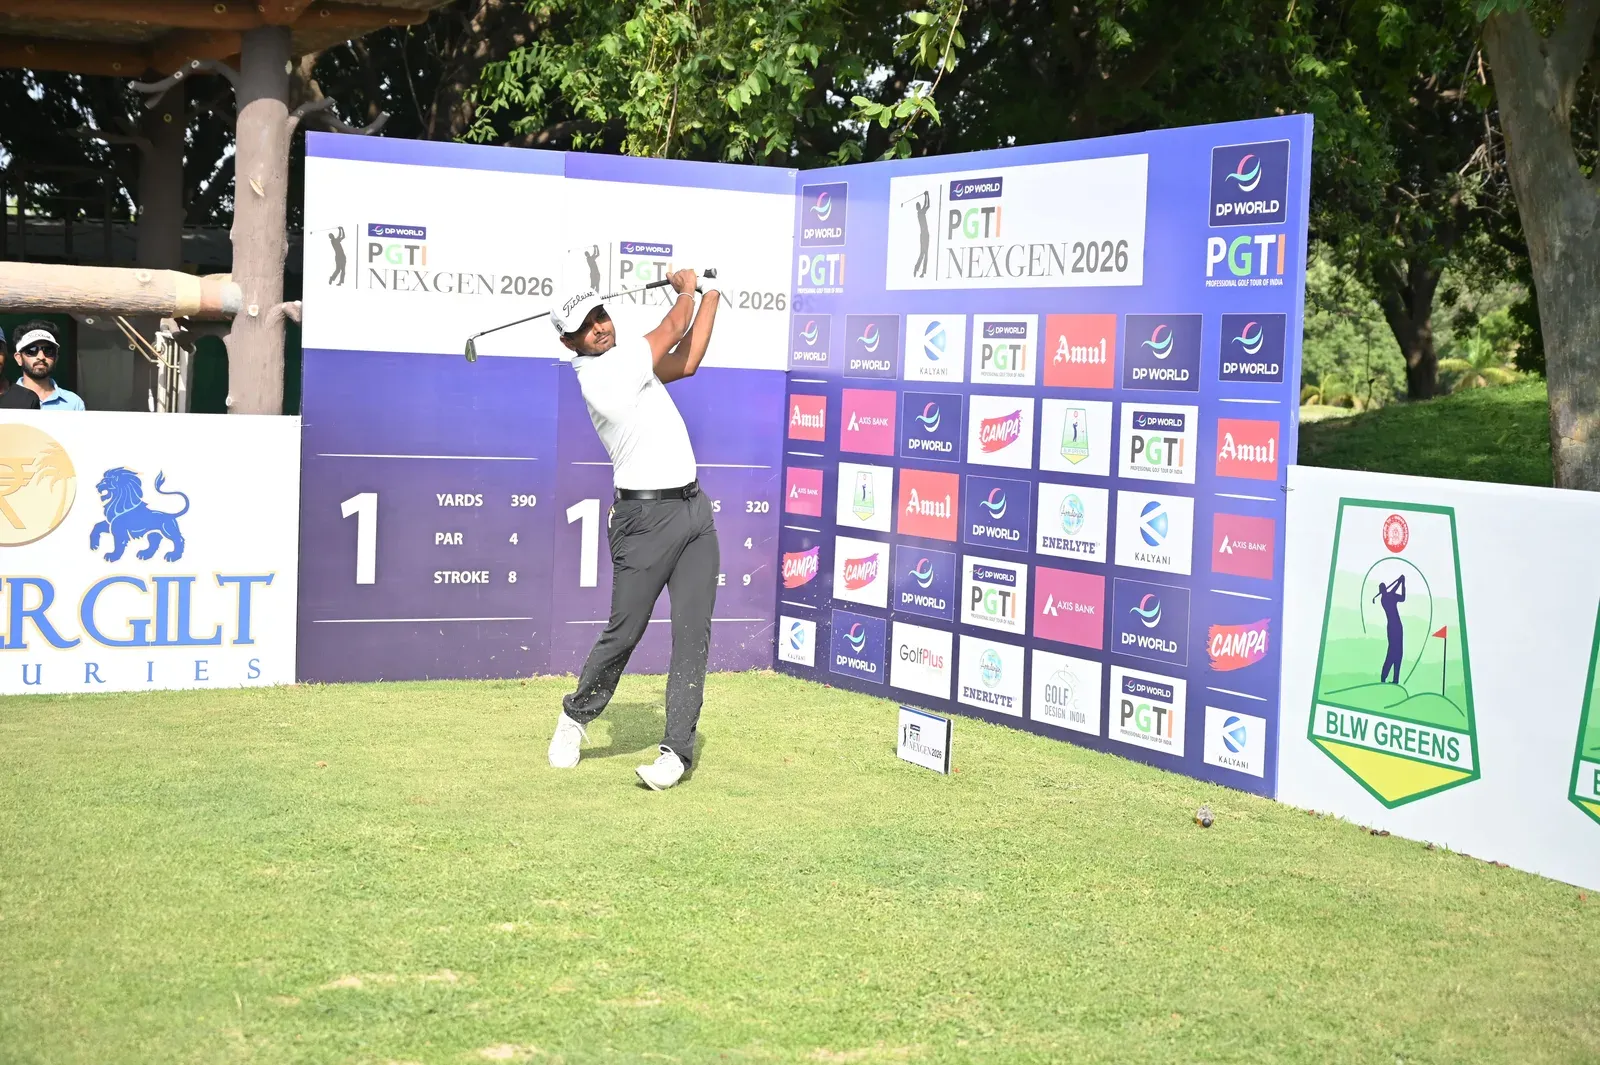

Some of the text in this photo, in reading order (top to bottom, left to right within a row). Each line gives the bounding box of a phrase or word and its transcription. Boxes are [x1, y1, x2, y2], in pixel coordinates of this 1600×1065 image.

[964, 183, 1000, 194] DP WORLD
[1216, 200, 1279, 216] DP WORLD
[949, 206, 1002, 240] PGTI
[396, 228, 424, 237] WORLD
[804, 228, 841, 238] DP WORLD
[368, 242, 427, 266] PGTI
[646, 246, 670, 254] WORLD
[1206, 234, 1286, 277] PGTI
[947, 240, 1128, 279] NEXGEN 2026
[798, 253, 846, 286] PGTI
[368, 268, 553, 297] NEXGEN 2026
[620, 284, 786, 311] NEXN 2026
[996, 326, 1004, 334] DP
[794, 352, 826, 361] DP WORLD
[981, 344, 1026, 371] PGTI
[1053, 335, 1106, 366] Amul
[850, 360, 890, 371] DP WORLD
[920, 368, 948, 376] KALYANI
[1133, 368, 1189, 381] DP WORLD
[1224, 363, 1279, 375] DP WORLD
[790, 405, 824, 429] Amul
[872, 418, 888, 426] BANK
[1148, 418, 1182, 427] DP WORLD
[982, 418, 1019, 443] CAMPA
[909, 439, 952, 452] DP WORLD
[1131, 435, 1184, 467] PGTI
[1219, 432, 1275, 464] Amul
[436, 494, 537, 507] YARDS 390
[746, 501, 769, 513] 320
[906, 488, 952, 519] Amul
[340, 492, 378, 585] 1
[436, 532, 518, 545] PAR 4
[973, 525, 1020, 541] DP WORLD
[566, 499, 600, 587] 1
[744, 538, 753, 550] 4
[1042, 536, 1095, 554] ENERLYTE
[1232, 541, 1266, 551] AXIS BANK
[784, 556, 818, 577] CAMPA
[1135, 552, 1171, 565] KALYANI
[434, 571, 517, 584] STROKE 8
[845, 559, 877, 581] CAMPA
[985, 570, 1014, 582] DP WORLD
[742, 574, 751, 586] 9
[81, 573, 275, 647] GILT
[902, 593, 946, 609] DP WORLD
[971, 586, 1016, 619] PGTI
[1057, 601, 1095, 614] AXIS BANK
[1122, 632, 1177, 653] DP WORLD
[1212, 630, 1267, 658] CAMPA
[837, 655, 876, 673] DP WORLD
[900, 644, 944, 669] GolfPlus
[963, 686, 1013, 708] ENERLYTE
[1045, 684, 1069, 706] GOLF
[1137, 684, 1171, 698] DP WORLD
[1045, 705, 1086, 724] DESIGN INDIA
[1121, 700, 1173, 739] PGTI
[1327, 711, 1460, 762] BLW GREENS
[1219, 756, 1249, 770] KALYANI
